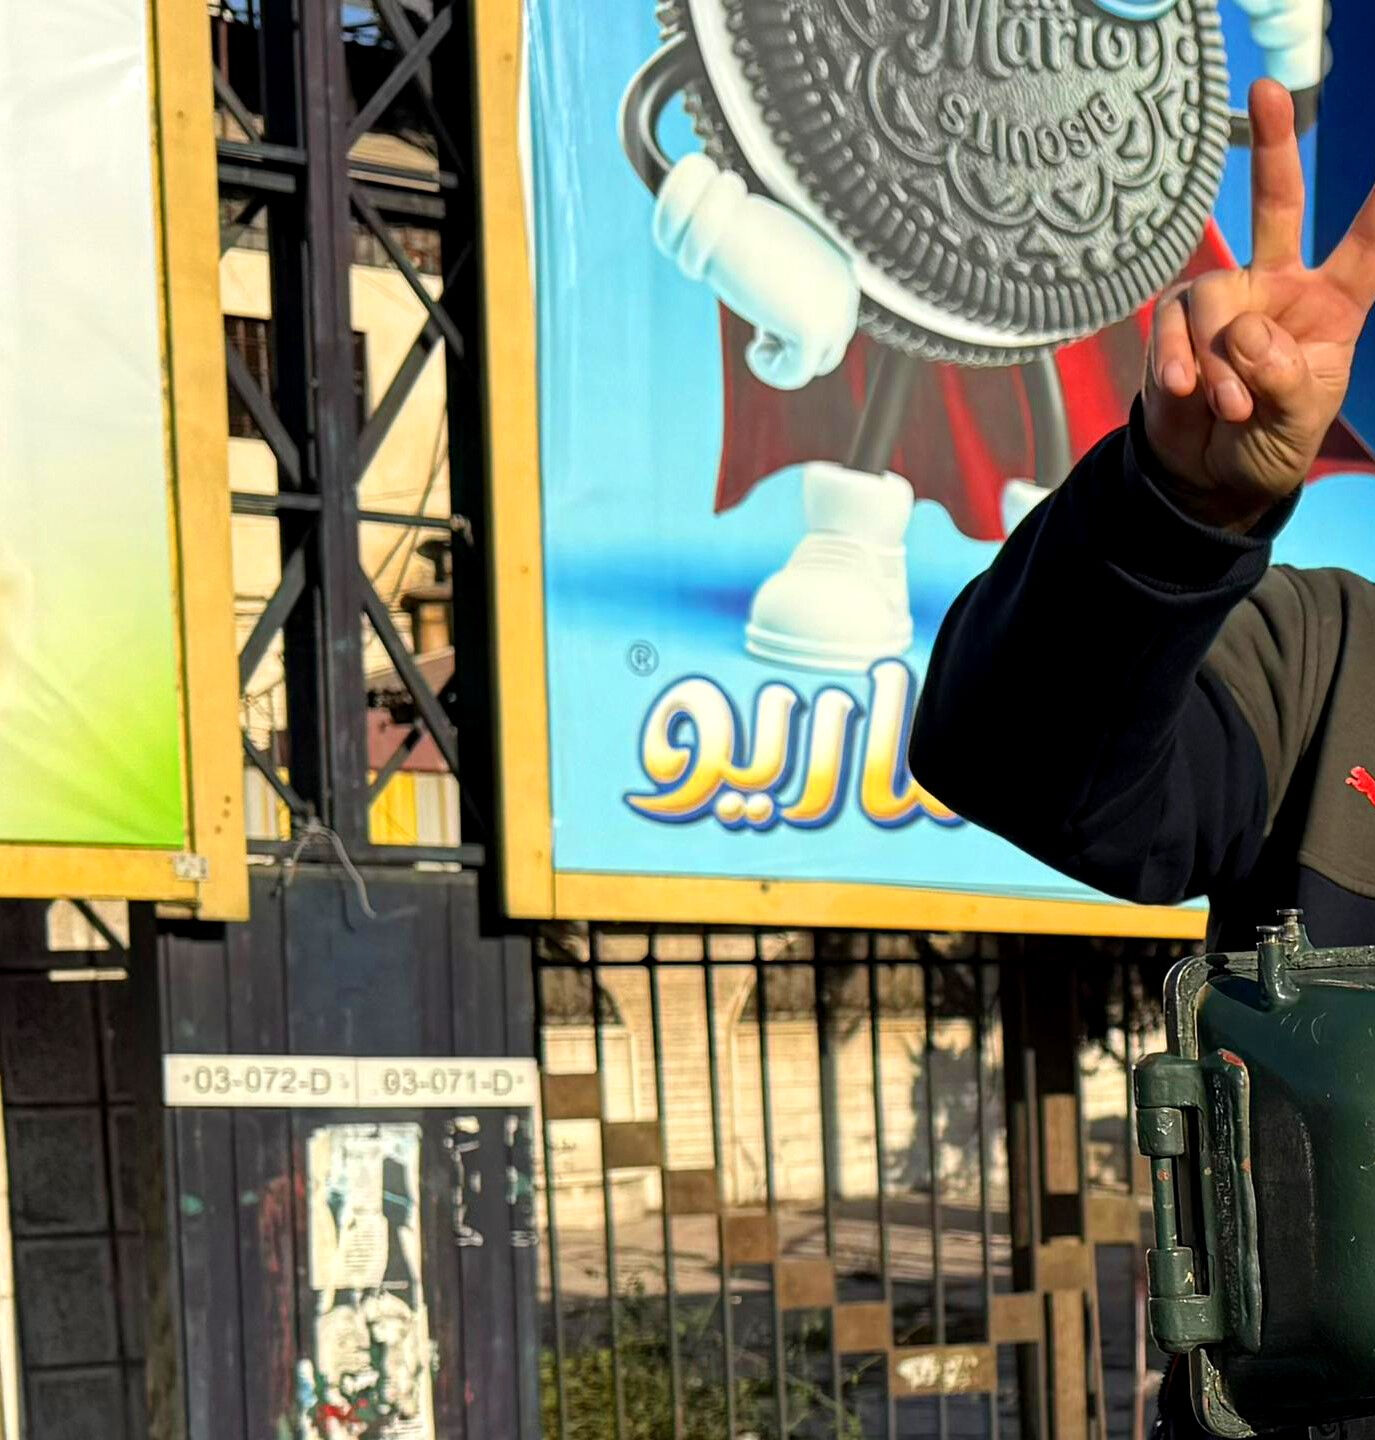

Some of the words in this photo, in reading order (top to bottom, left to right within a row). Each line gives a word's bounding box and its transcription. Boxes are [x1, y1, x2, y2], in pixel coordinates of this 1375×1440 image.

[621, 656, 970, 832] اريو
[194, 1064, 332, 1096] 03-072-D
[383, 1067, 513, 1097] 03-071-D
